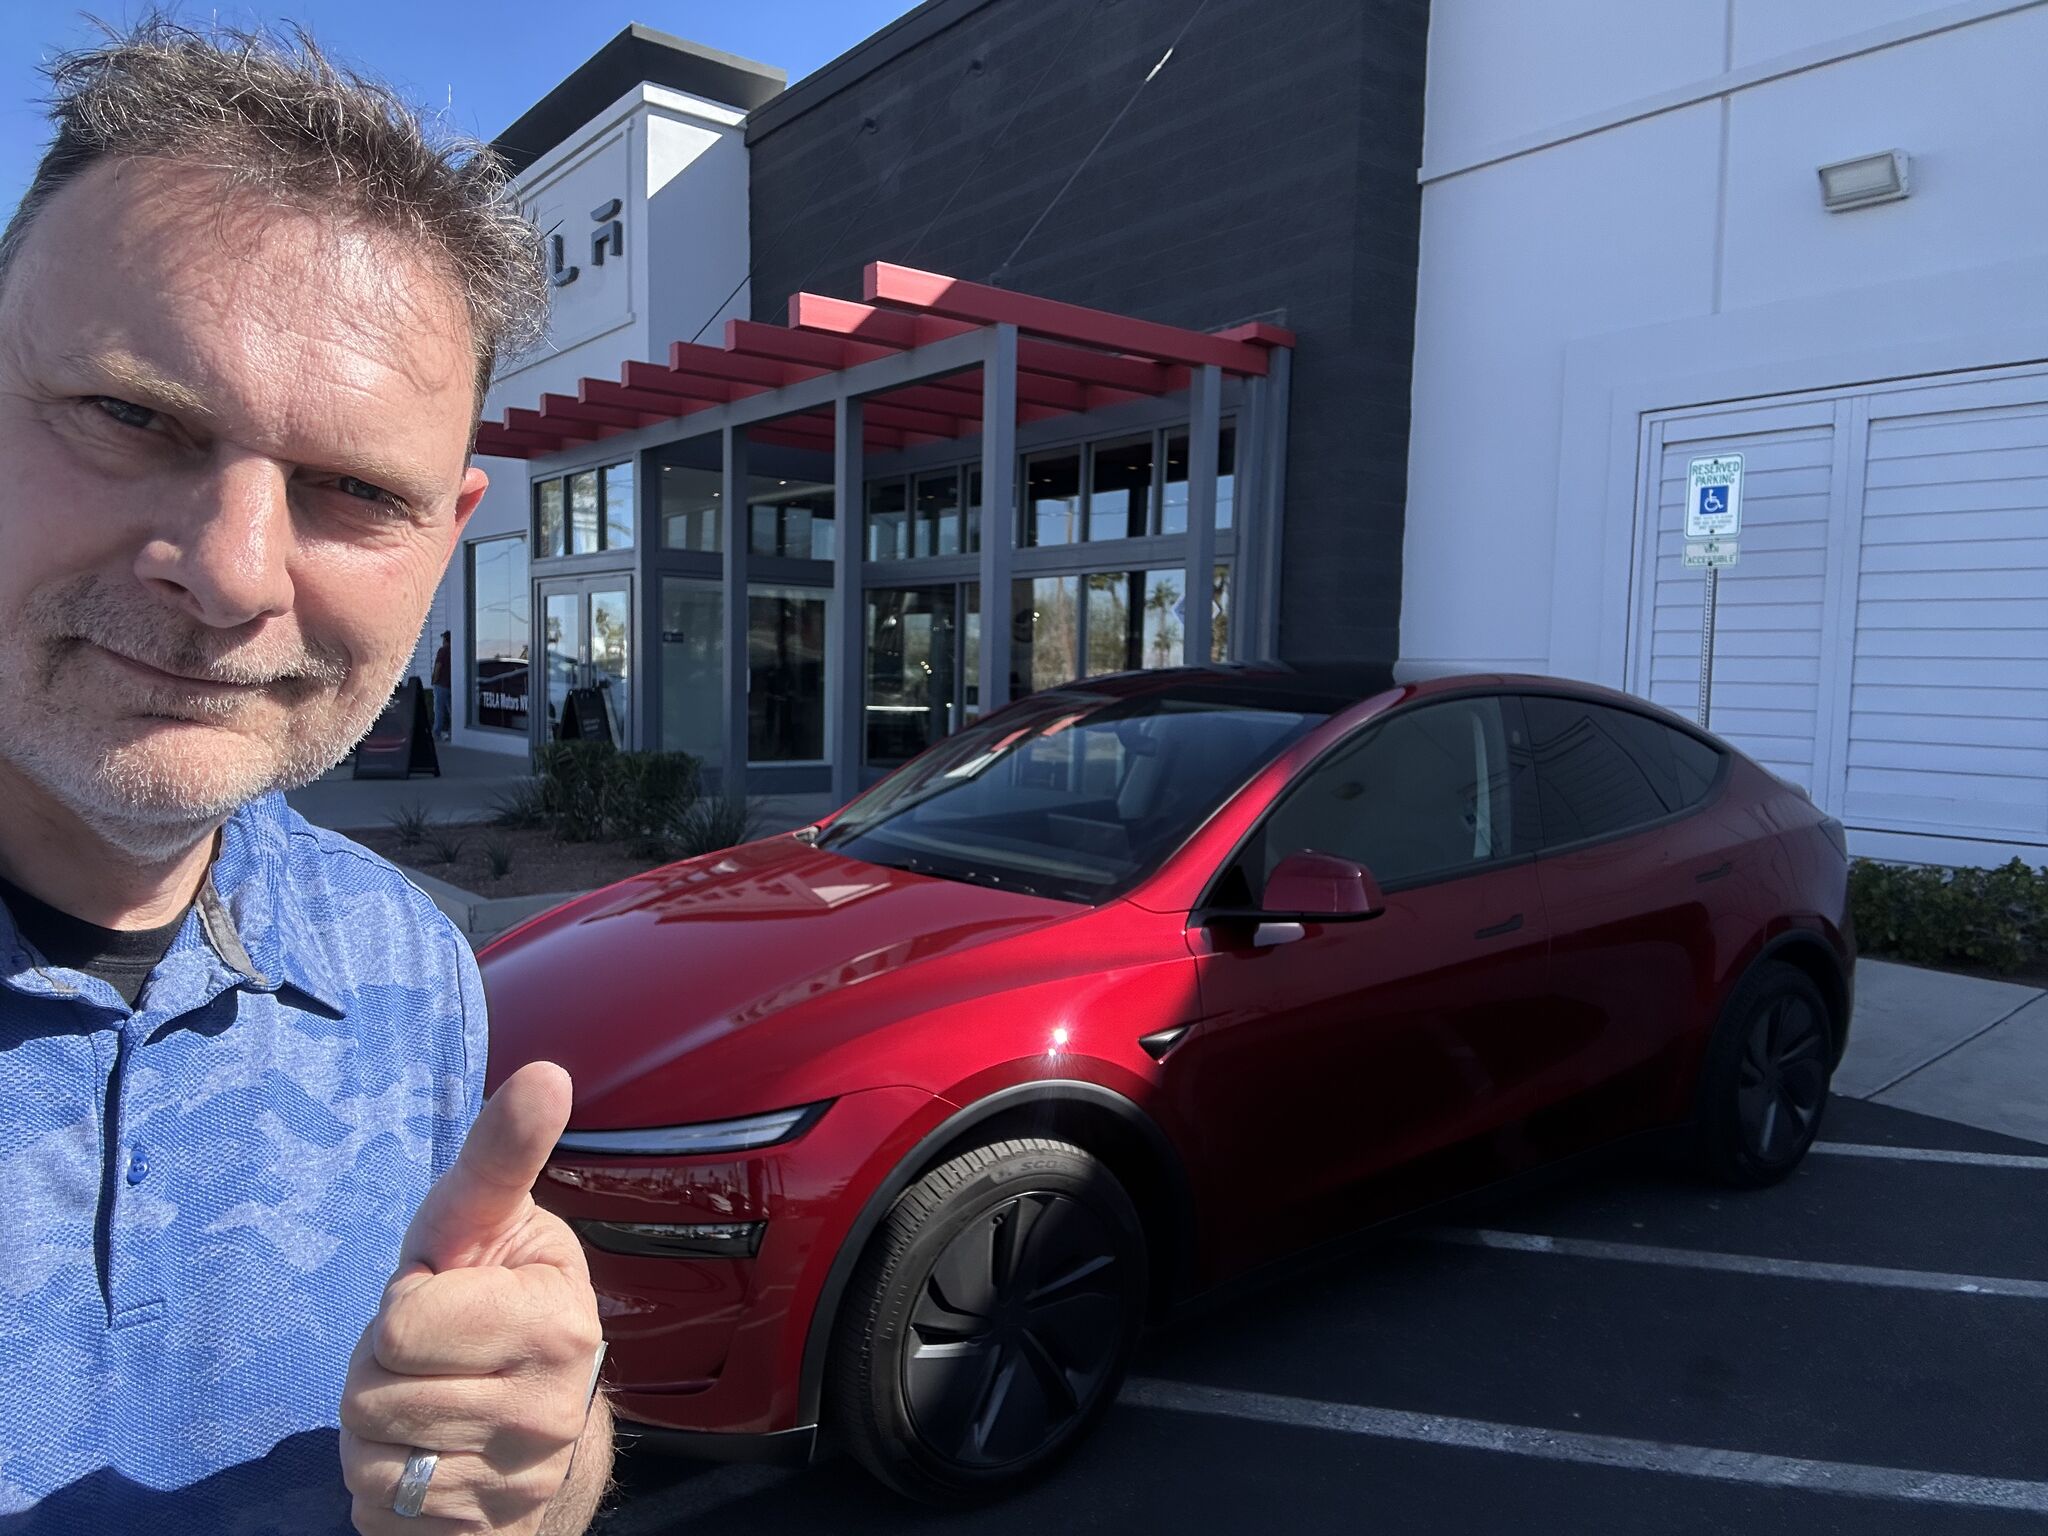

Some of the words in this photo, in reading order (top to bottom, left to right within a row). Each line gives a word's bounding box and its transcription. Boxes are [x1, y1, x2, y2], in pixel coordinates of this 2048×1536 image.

[1692, 461, 1739, 476] RESERVED
[1695, 473, 1735, 486] PARKING
[483, 691, 500, 708] TESLA
[500, 692, 519, 711] Motors
